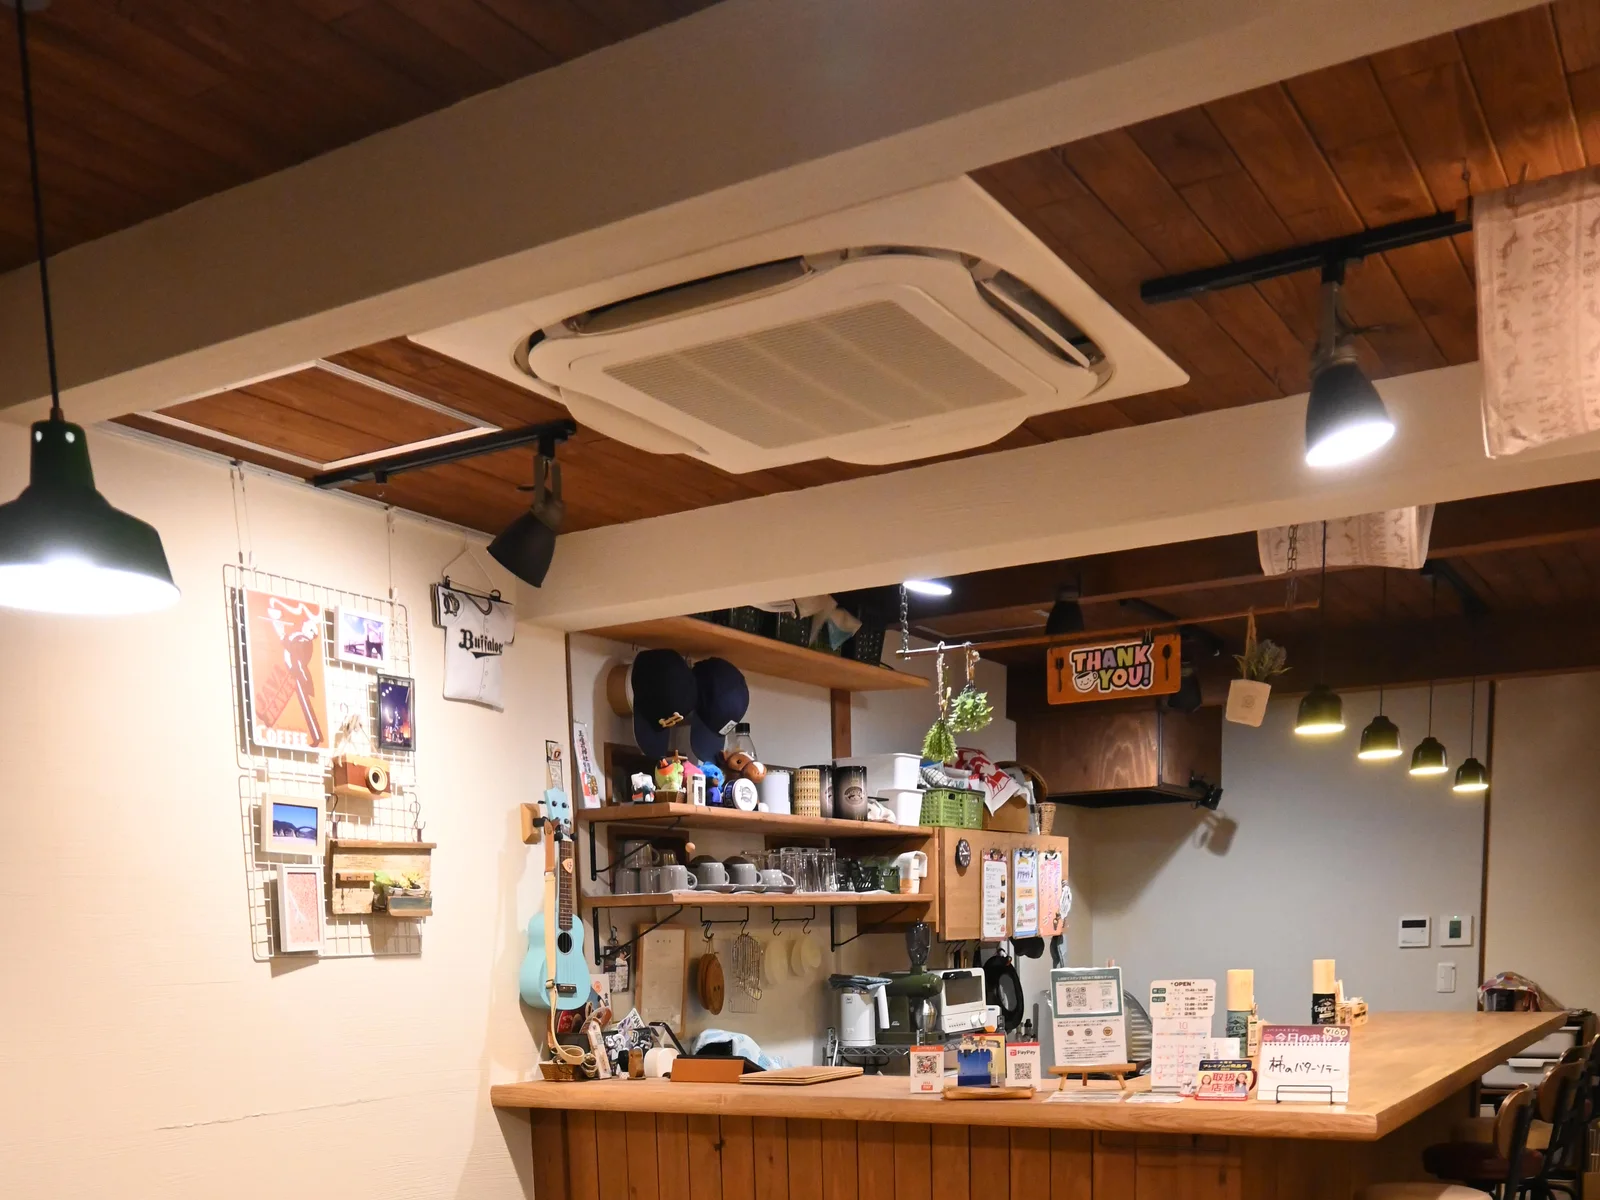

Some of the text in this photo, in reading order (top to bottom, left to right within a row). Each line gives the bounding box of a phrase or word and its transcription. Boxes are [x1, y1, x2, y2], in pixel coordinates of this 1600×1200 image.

[1072, 644, 1151, 673] THANK
[1099, 663, 1151, 690] YOU!
[255, 725, 309, 746] COFFEE
[1212, 1072, 1236, 1082] 取扱
